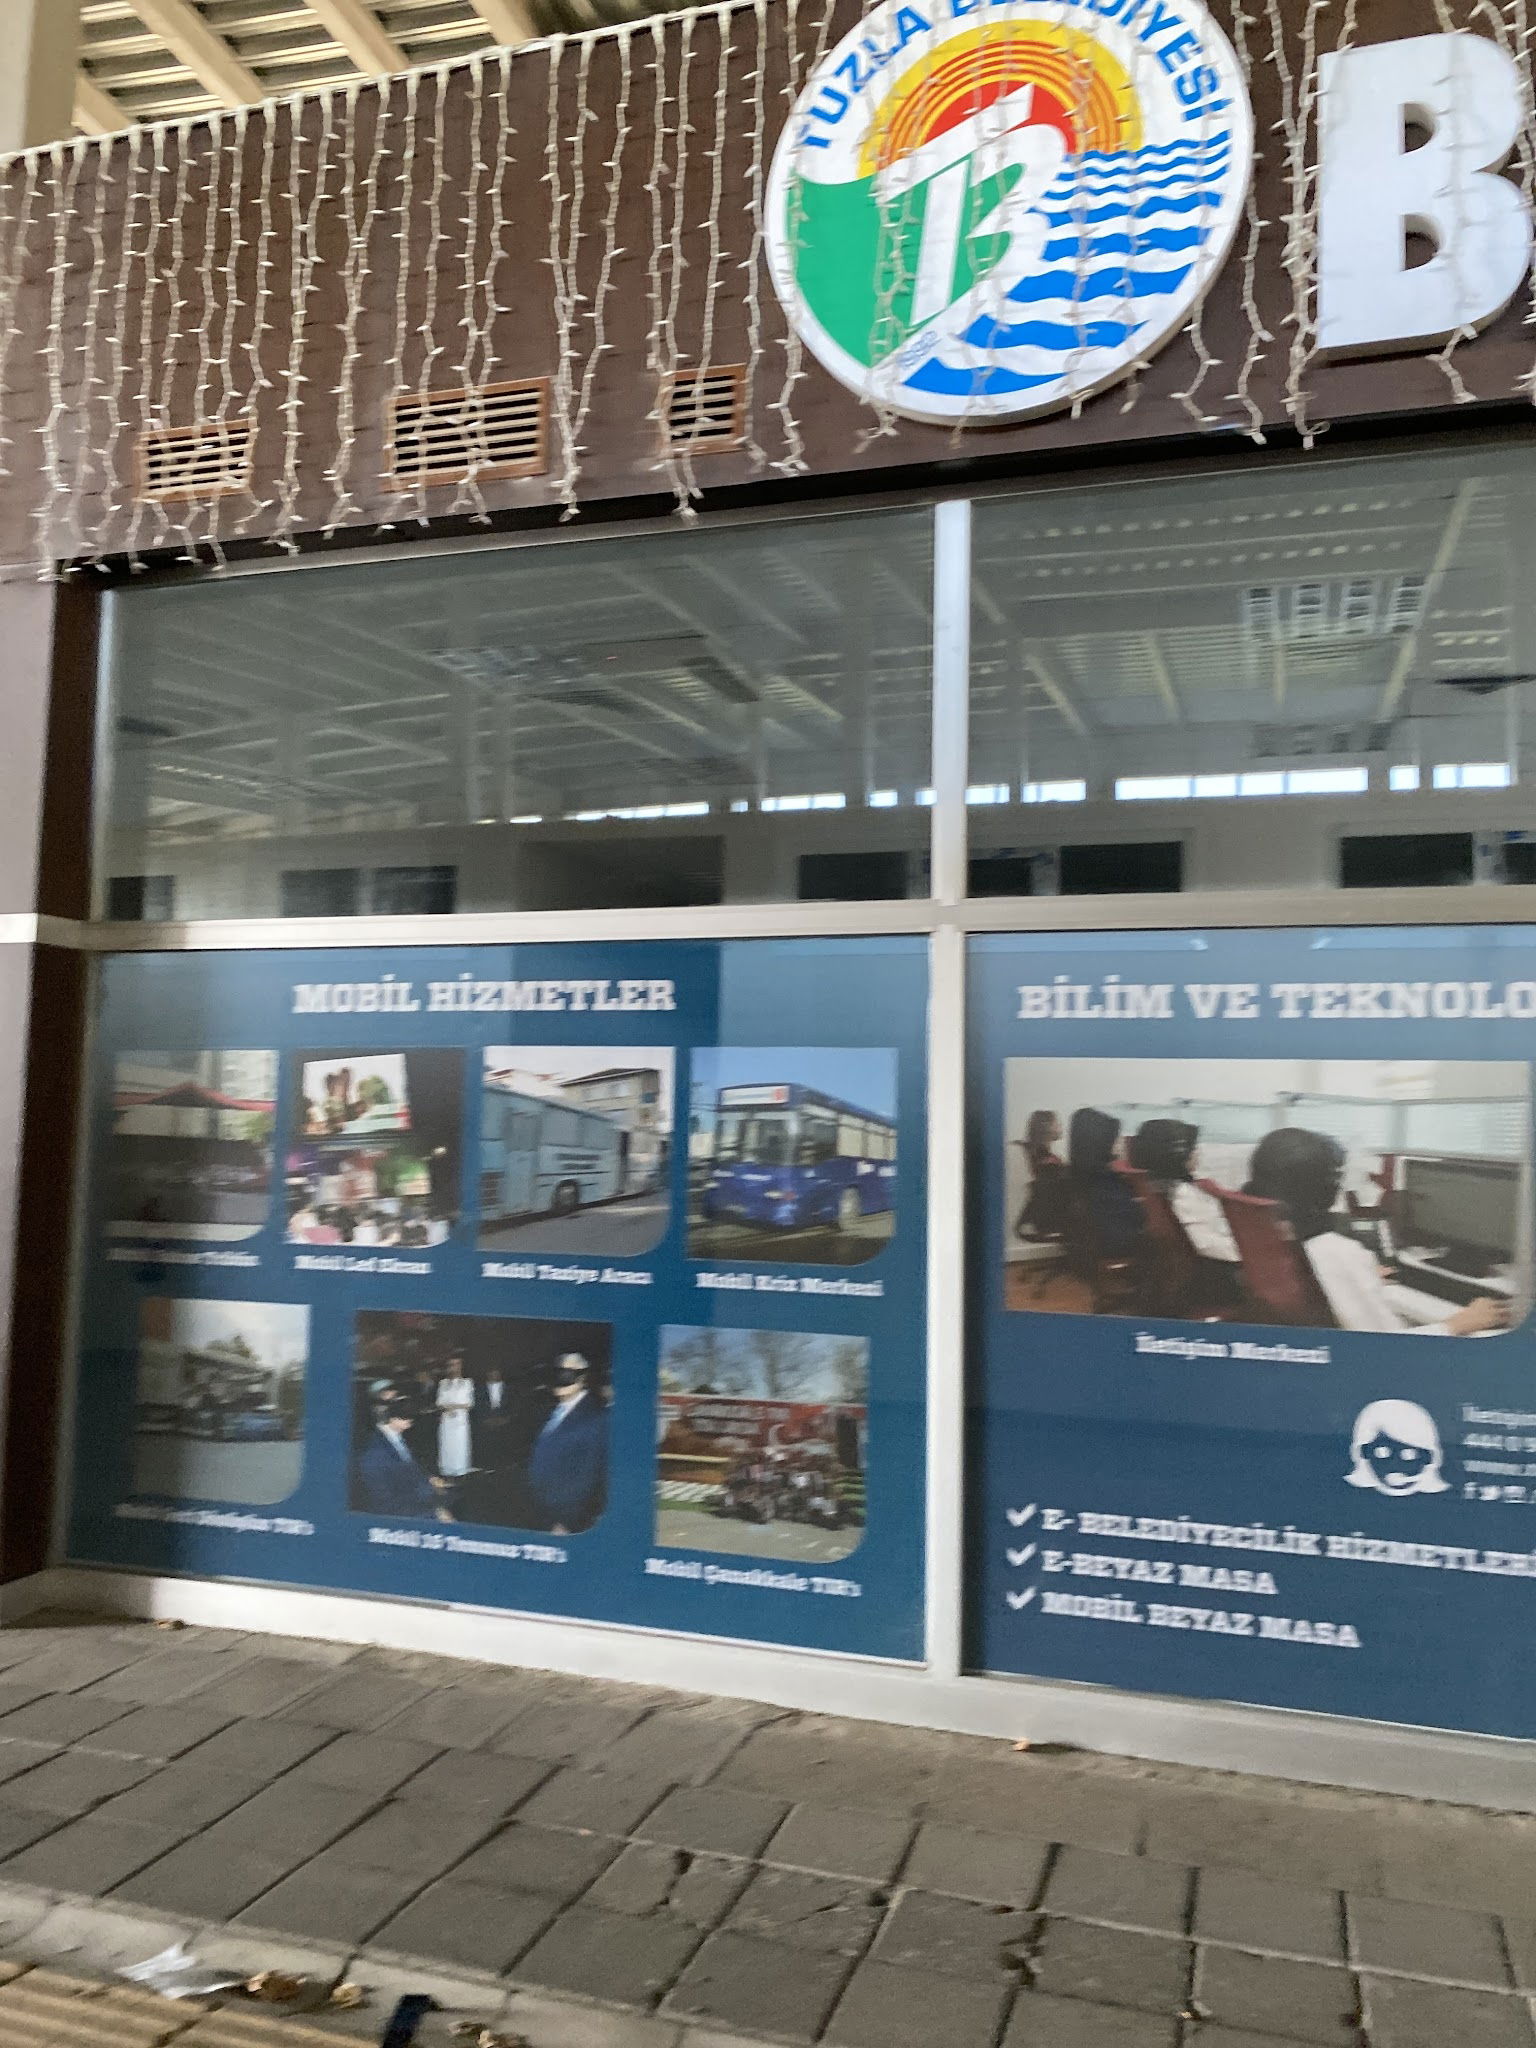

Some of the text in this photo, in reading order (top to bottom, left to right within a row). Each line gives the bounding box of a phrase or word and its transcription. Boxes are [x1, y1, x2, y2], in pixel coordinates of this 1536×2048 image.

[799, 6, 932, 149] TUZLA
[1317, 32, 1533, 351] B
[292, 973, 677, 1013] MOBİL HİZMETLER
[1017, 975, 1536, 1018] BİLİM VE TEKNOLO
[1178, 1563, 1279, 1595] MASA
[1041, 1591, 1363, 1648] MOBİL BEYAZ MASA
